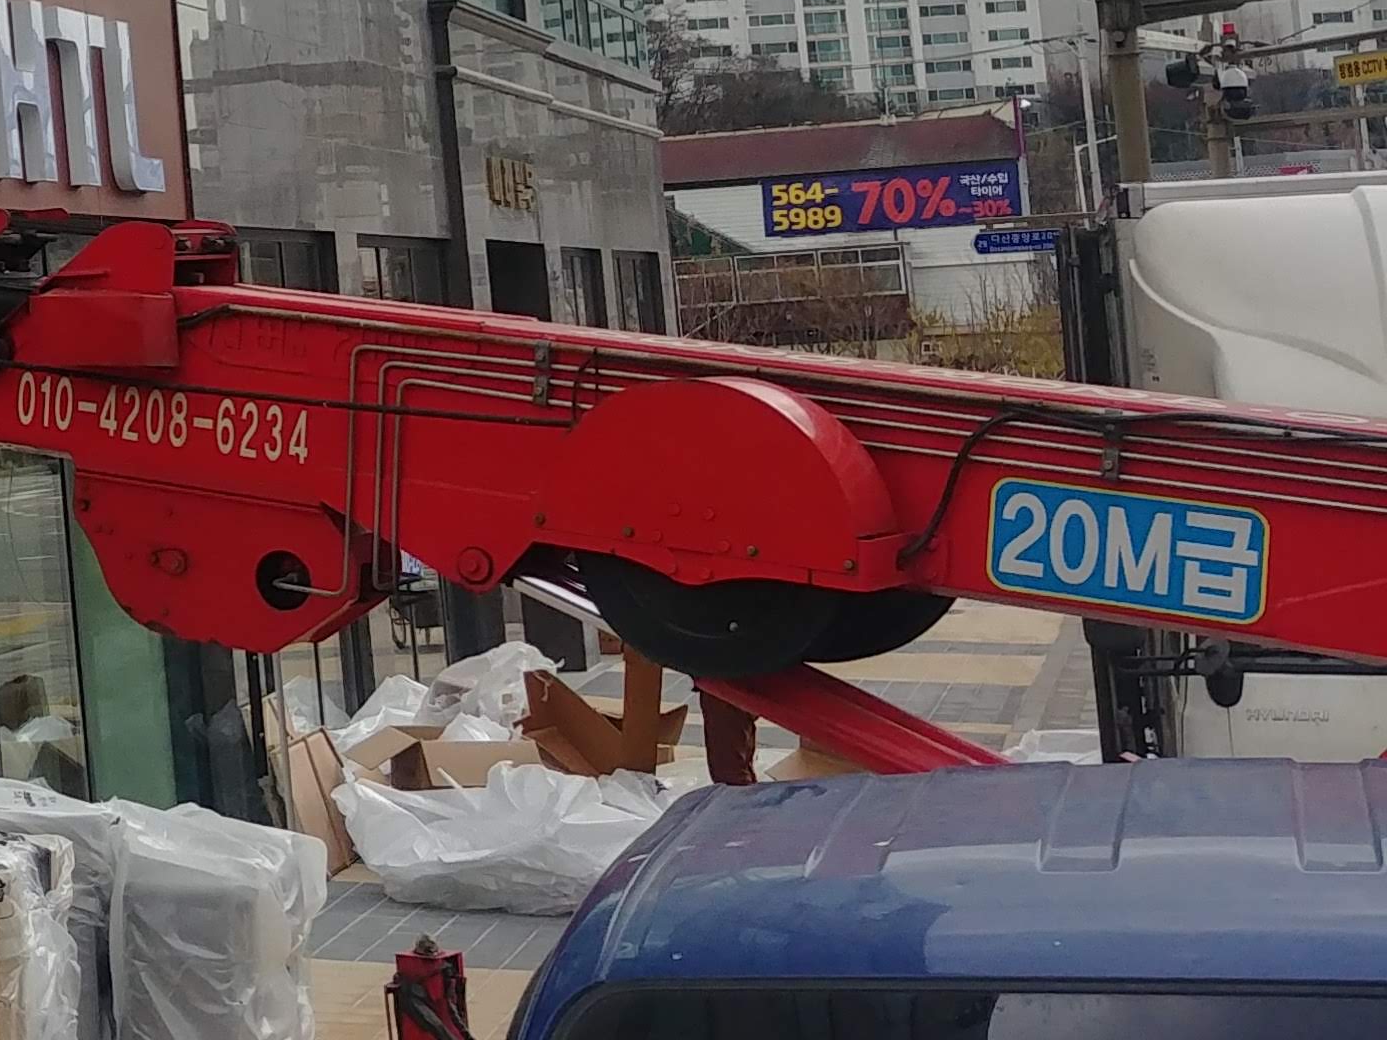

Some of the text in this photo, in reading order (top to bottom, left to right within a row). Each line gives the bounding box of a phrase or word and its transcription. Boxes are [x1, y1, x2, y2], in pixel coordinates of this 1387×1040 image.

[1362, 59, 1382, 74] CCTV
[959, 172, 1009, 186] 국산/수입
[971, 185, 1003, 197] 타이어
[771, 181, 838, 206] 564-
[852, 176, 956, 224] 70%
[772, 206, 843, 231] 5989
[16, 370, 310, 465] 010-4208-6234
[998, 493, 1259, 614] 20M급
